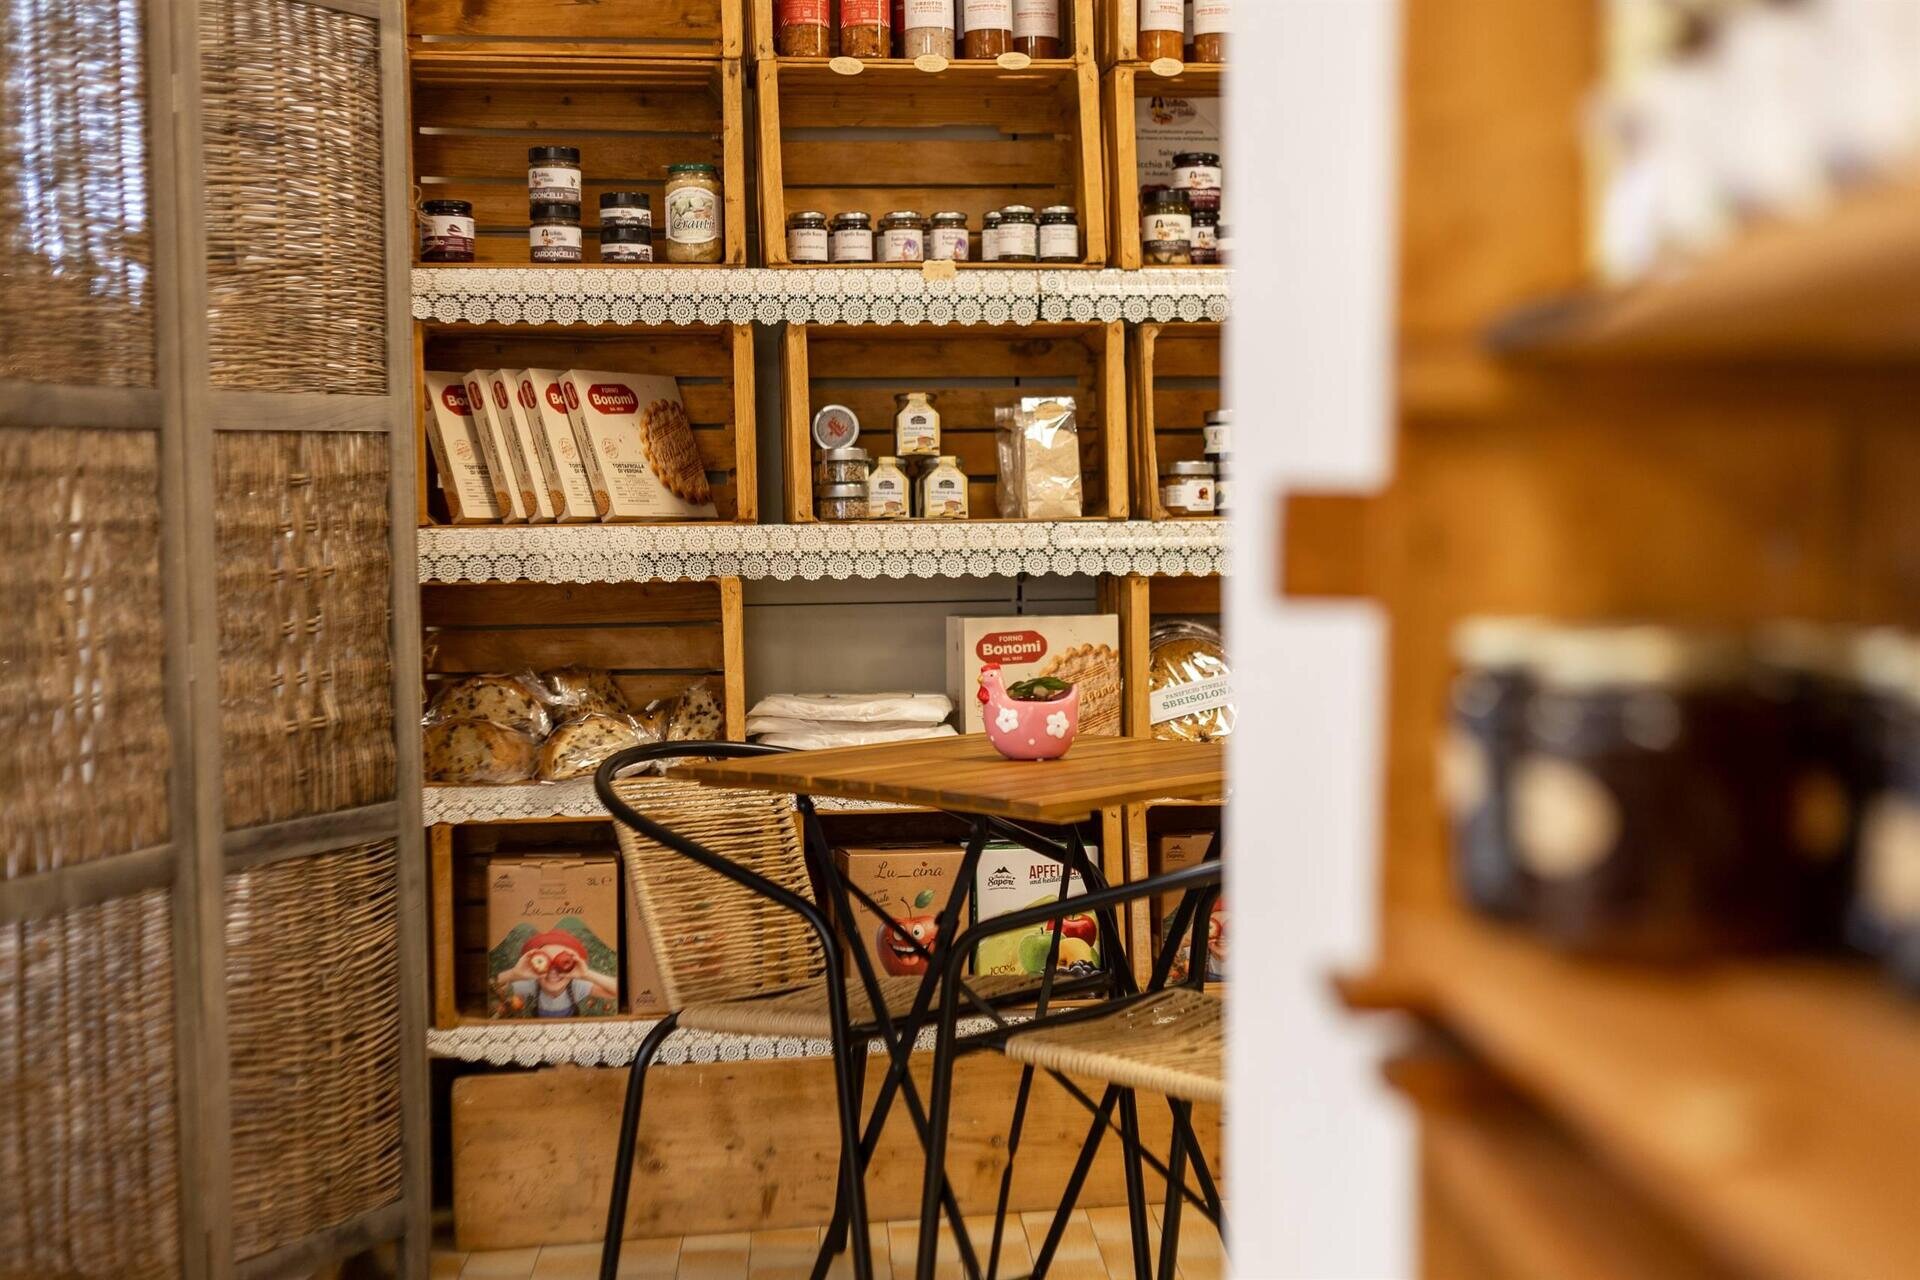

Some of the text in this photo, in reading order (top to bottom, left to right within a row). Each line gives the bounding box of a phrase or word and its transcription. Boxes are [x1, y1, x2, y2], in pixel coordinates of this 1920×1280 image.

[591, 393, 635, 406] Bonomi
[982, 640, 1041, 656] Bonomi
[987, 876, 1016, 887] Sapori
